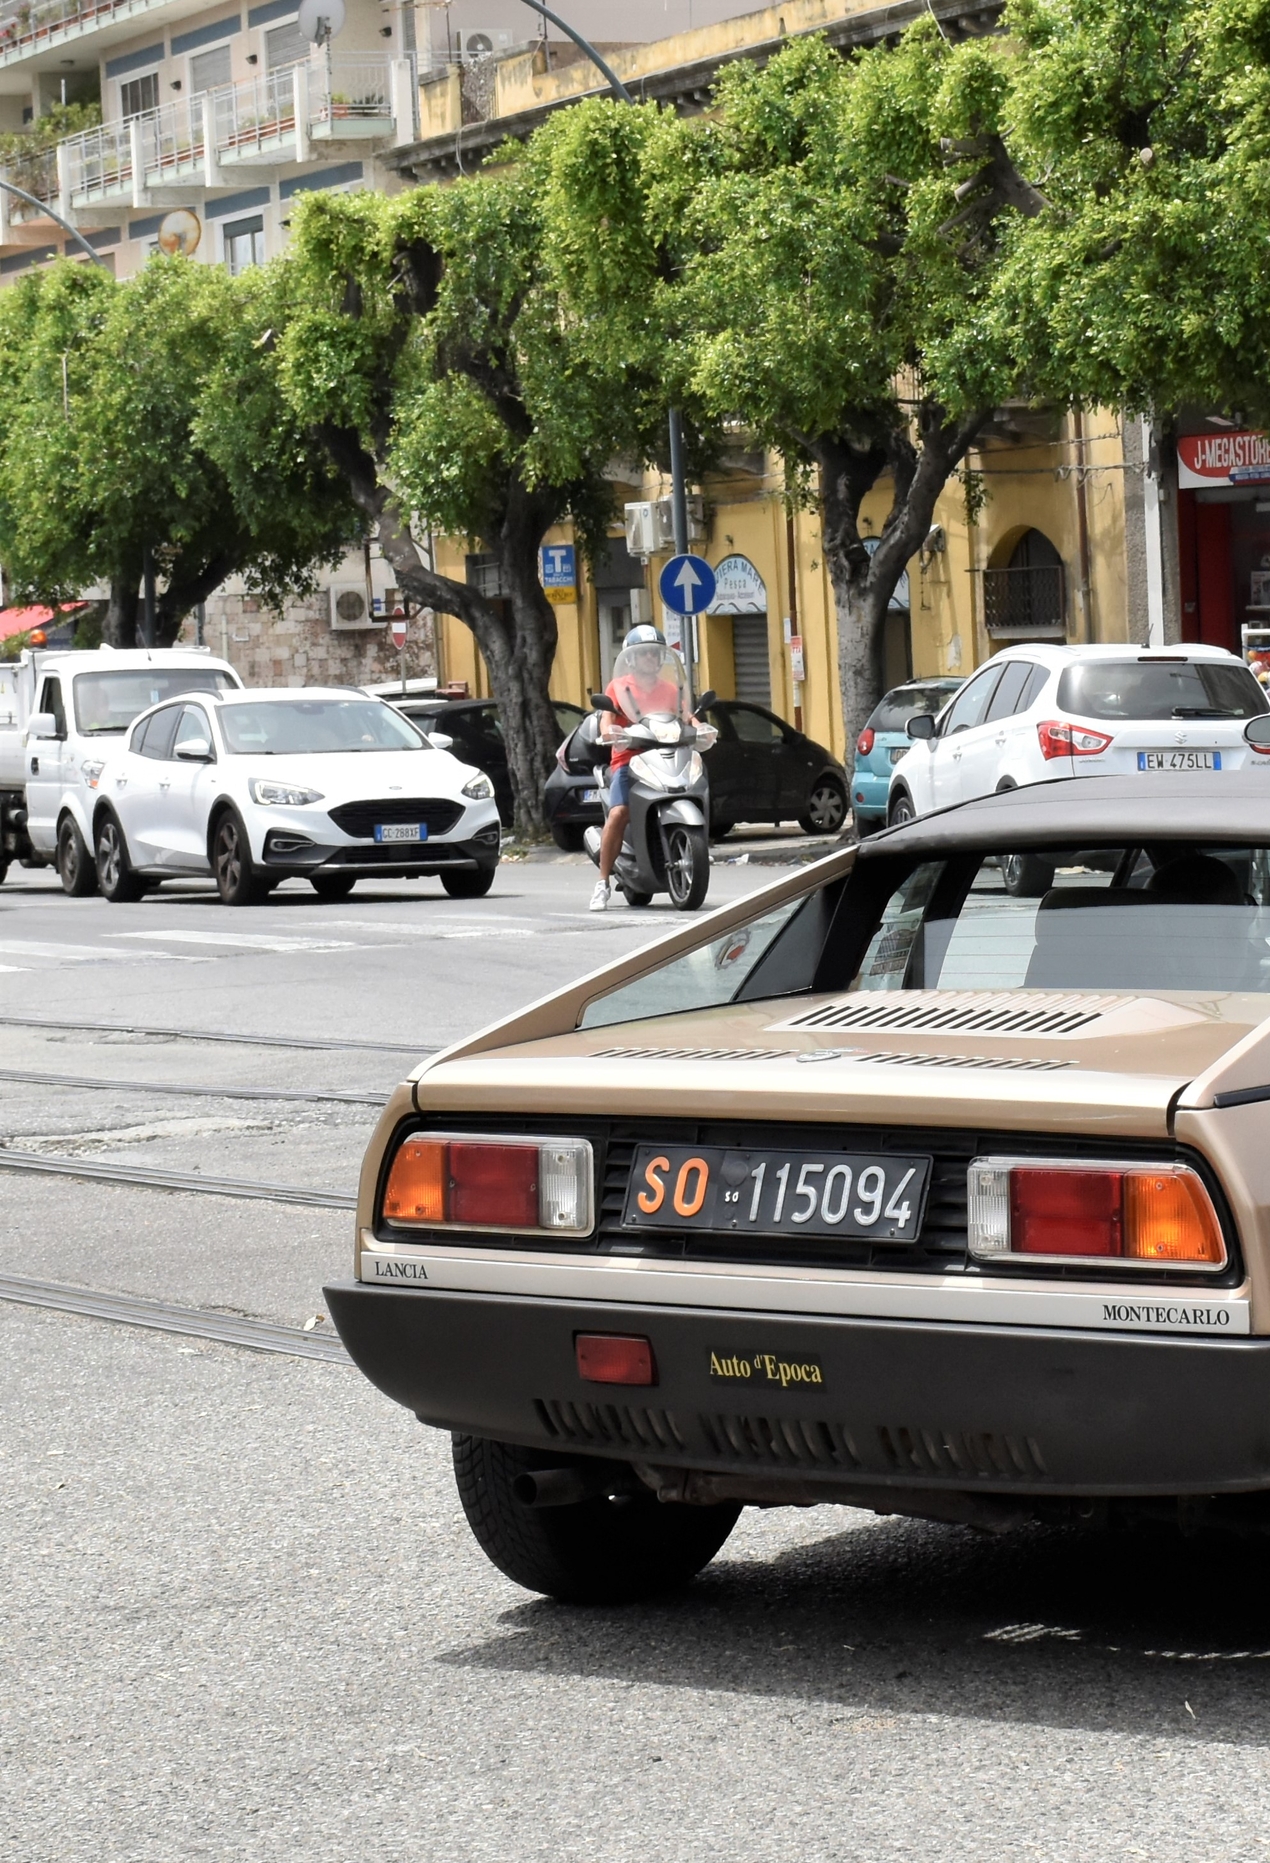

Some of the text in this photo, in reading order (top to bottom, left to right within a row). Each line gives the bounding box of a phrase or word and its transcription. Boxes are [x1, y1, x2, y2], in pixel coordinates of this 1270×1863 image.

[549, 550, 566, 573] T
[724, 577, 747, 589] Pesca
[741, 562, 764, 596] MARE
[1147, 753, 1212, 769] EW 475LL
[637, 1156, 709, 1217] SO
[749, 1161, 916, 1228] 115094
[375, 1261, 428, 1279] LANCIA
[1103, 1305, 1230, 1326] MONTECARLO
[710, 1351, 751, 1378] Auto
